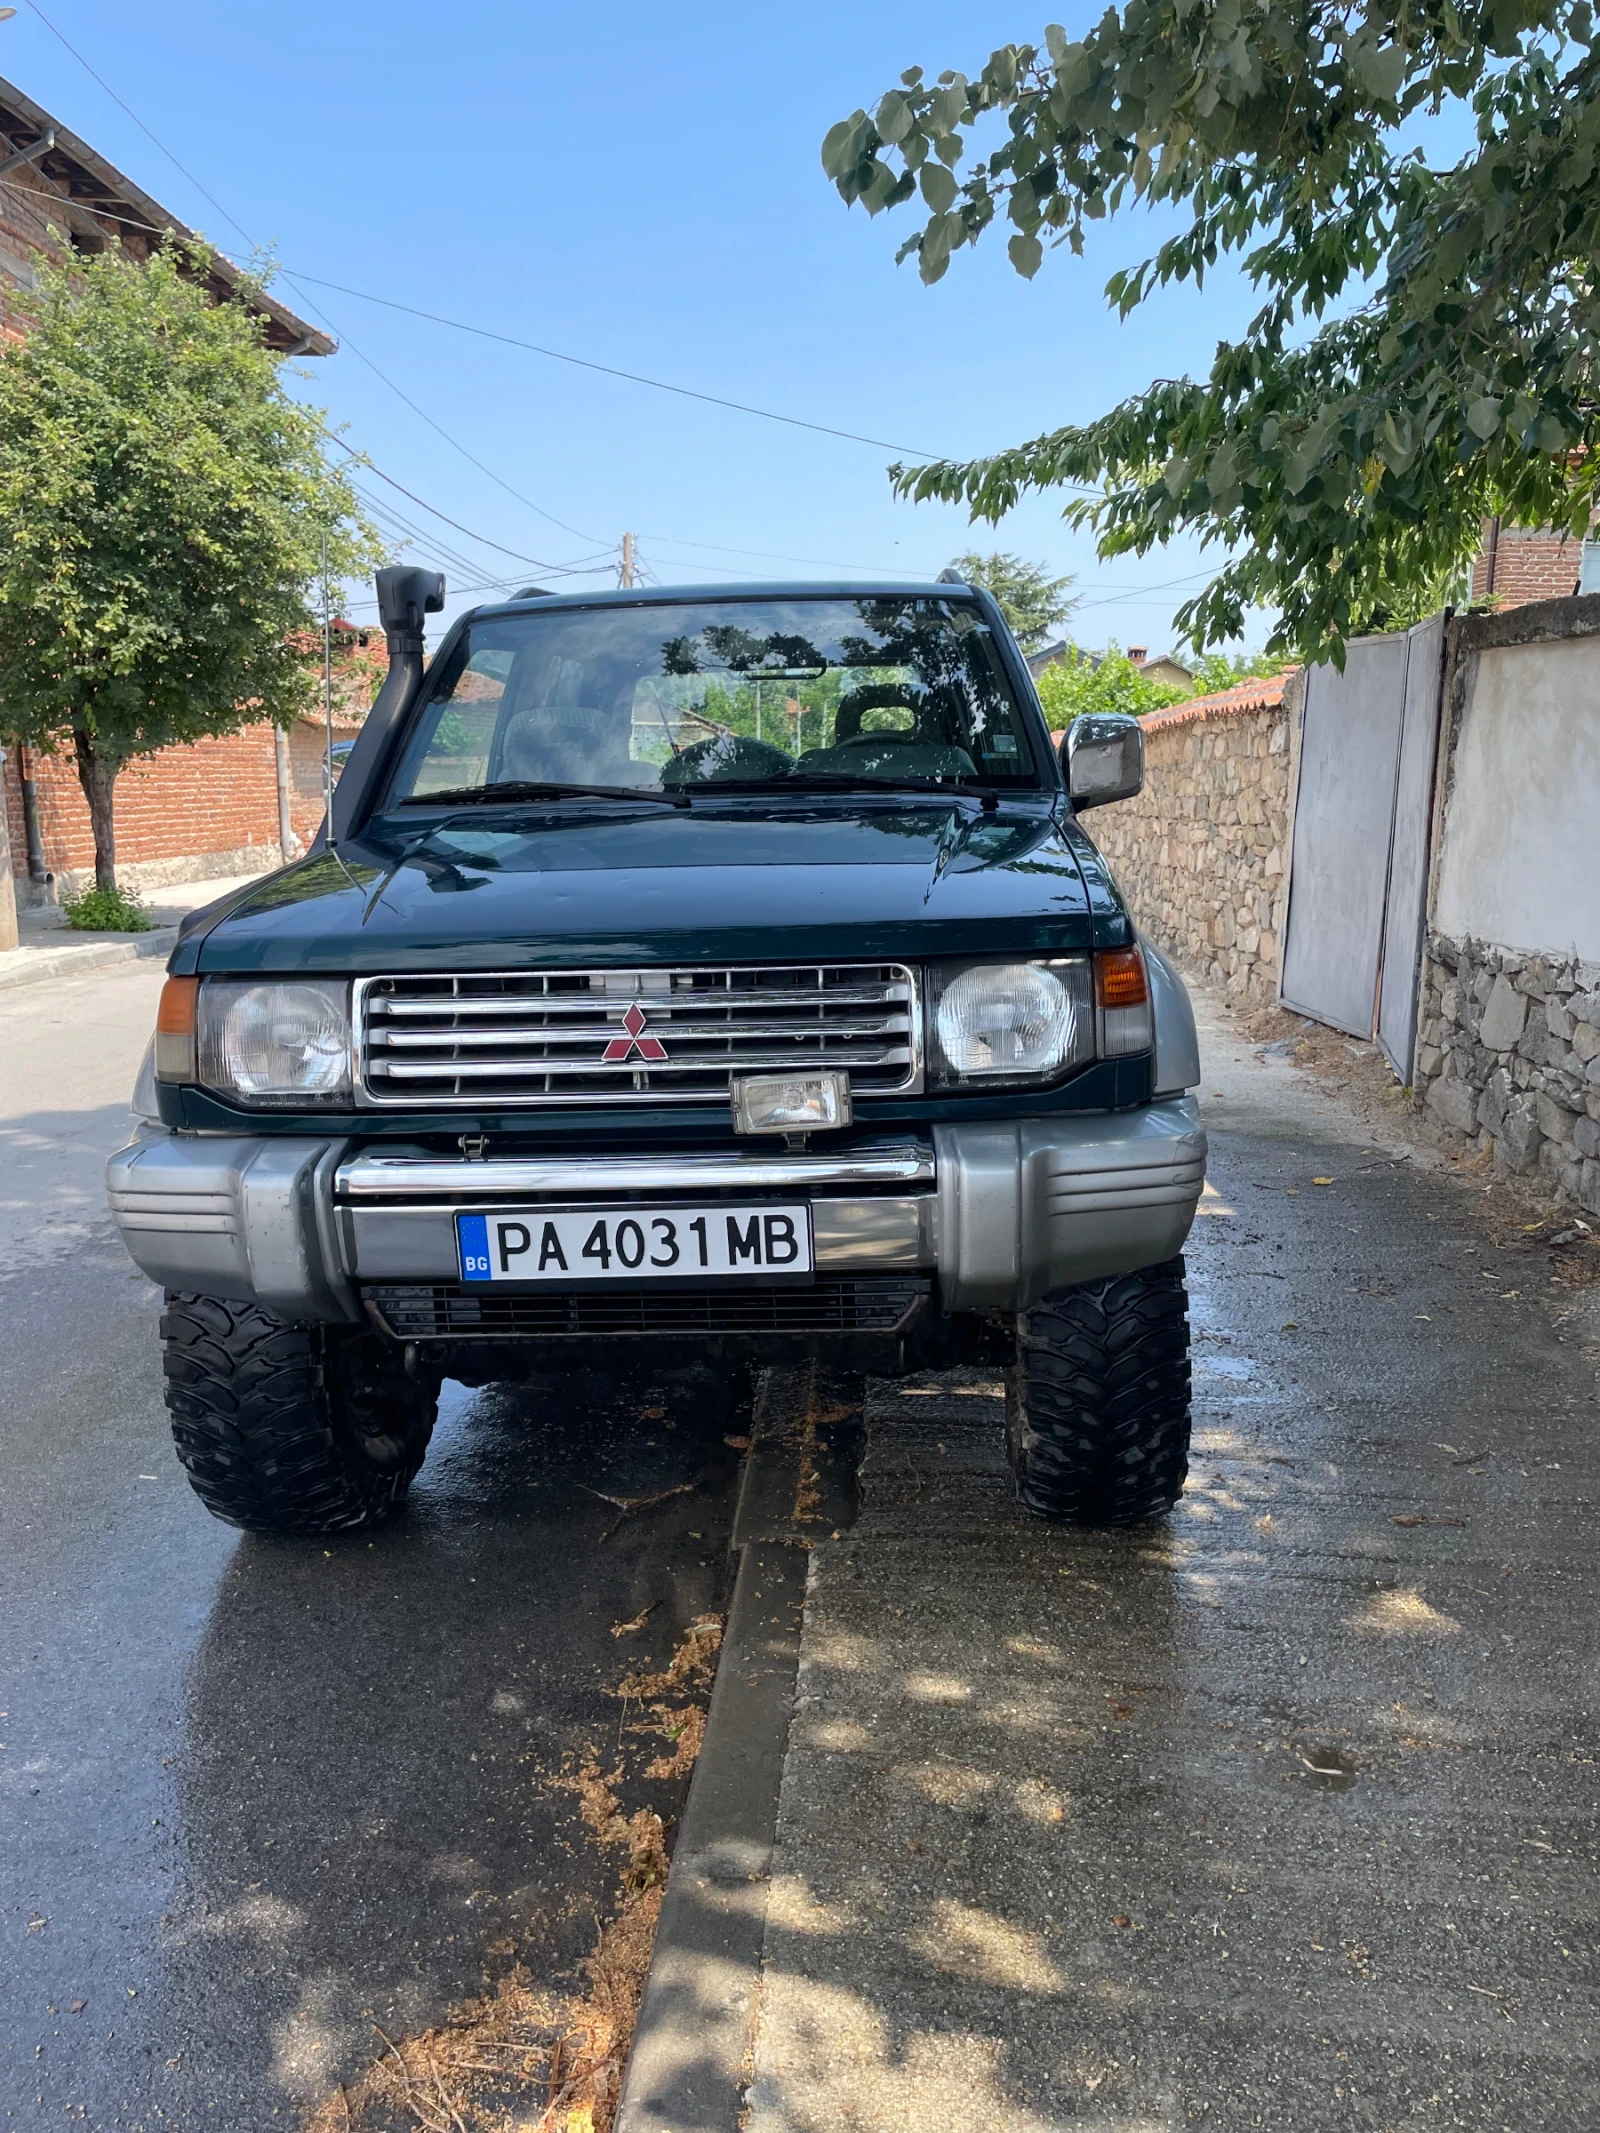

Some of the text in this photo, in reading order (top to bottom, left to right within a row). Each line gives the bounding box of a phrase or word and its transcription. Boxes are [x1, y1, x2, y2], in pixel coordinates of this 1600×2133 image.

[496, 1214, 799, 1272] PA 4031 MB
[465, 1256, 488, 1272] BG
